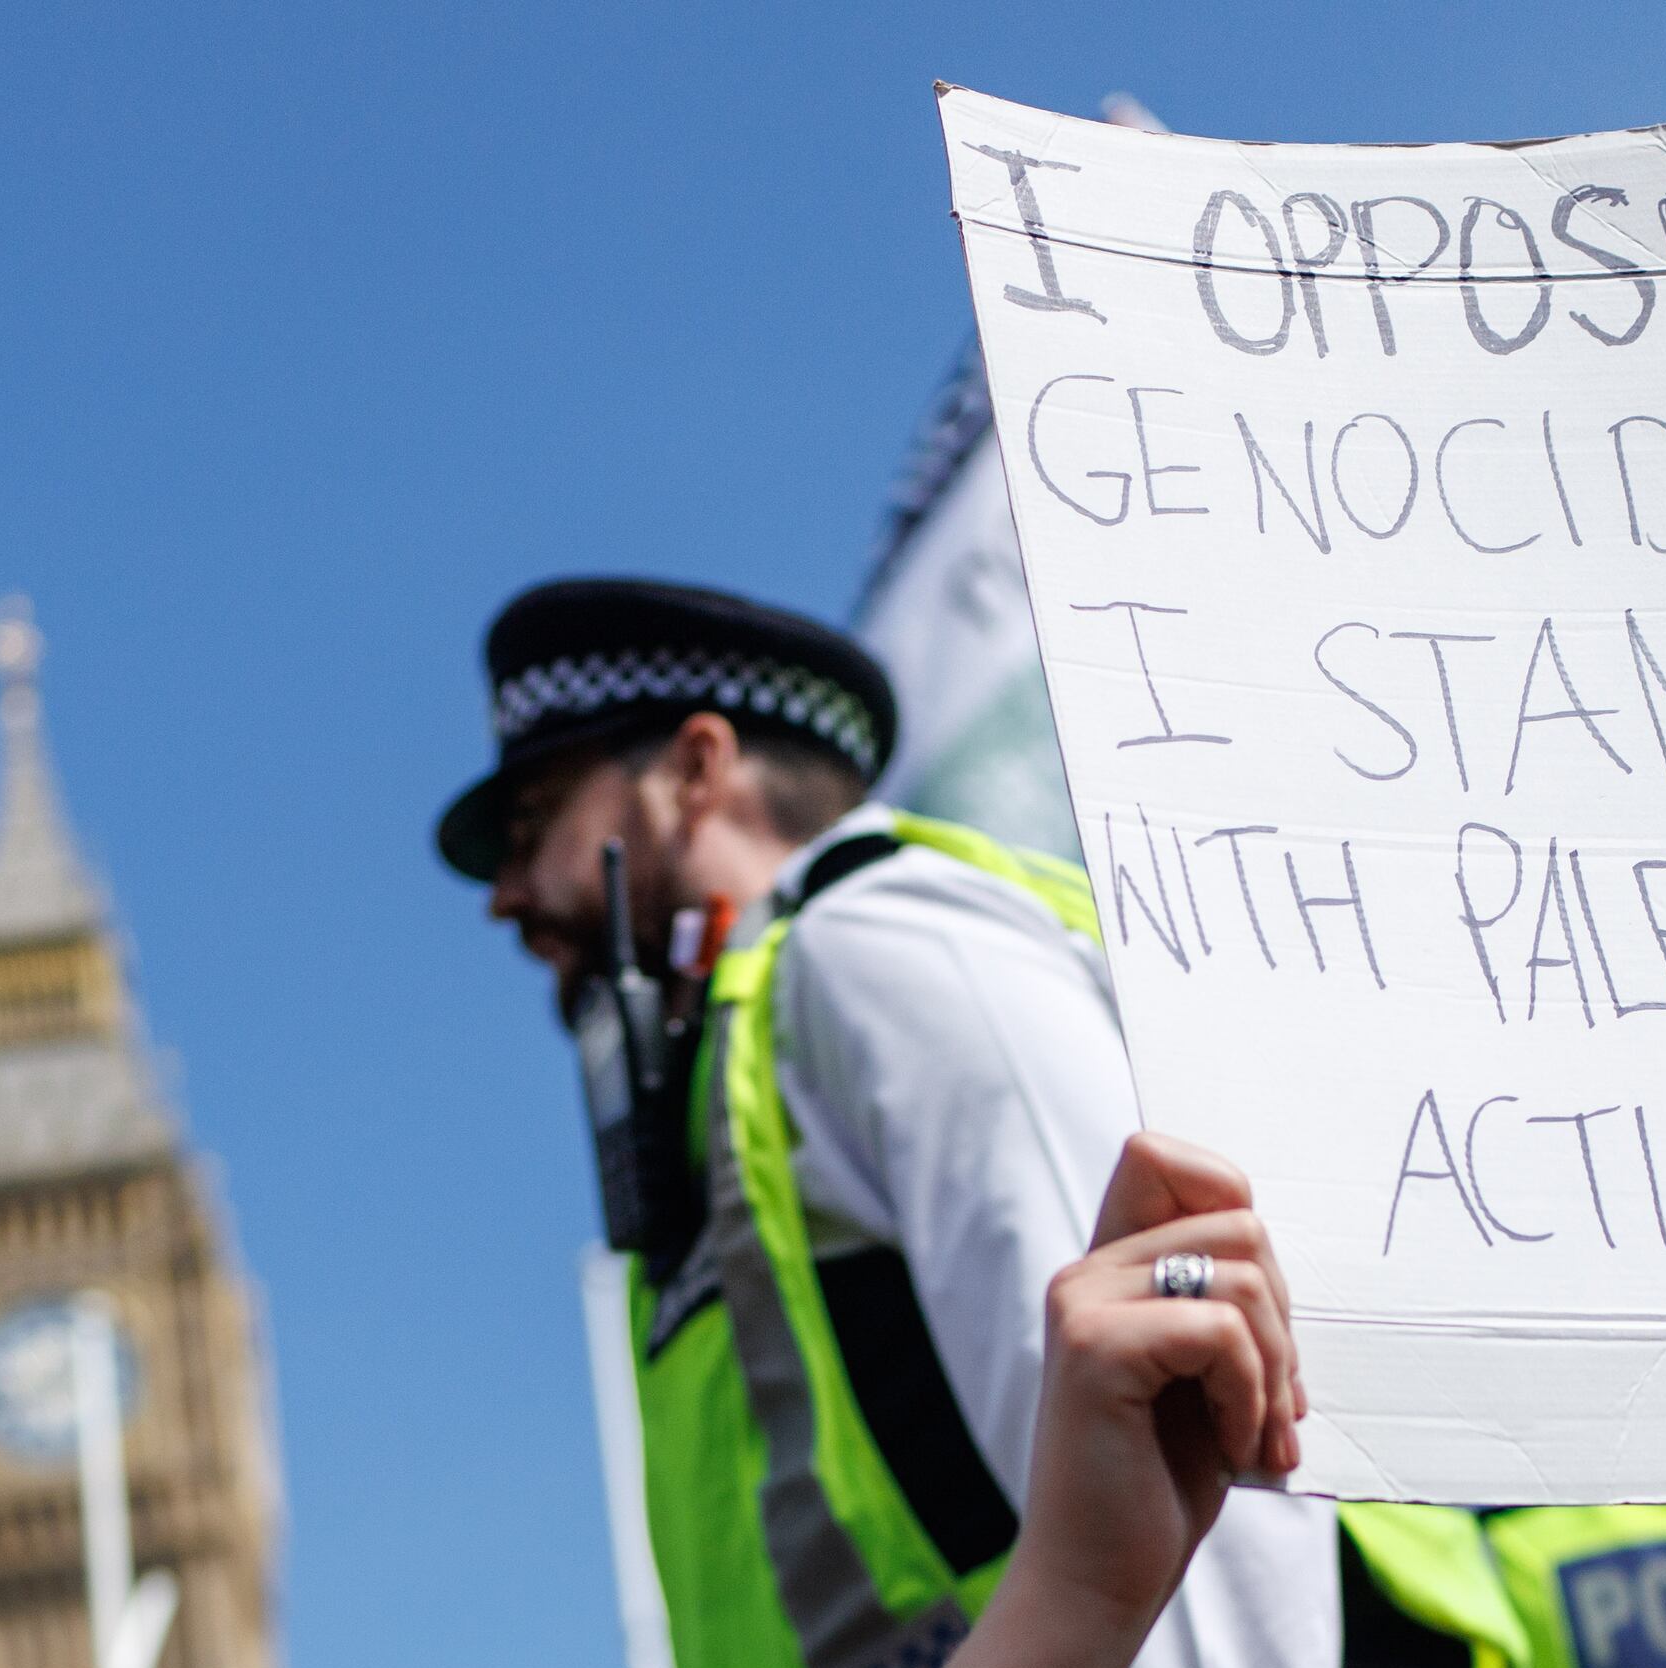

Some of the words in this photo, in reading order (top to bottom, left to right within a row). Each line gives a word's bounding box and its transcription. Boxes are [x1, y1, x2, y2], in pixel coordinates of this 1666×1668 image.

[961, 140, 1108, 325] I
[1069, 601, 1232, 749] I
[1104, 802, 1387, 991] WITH
